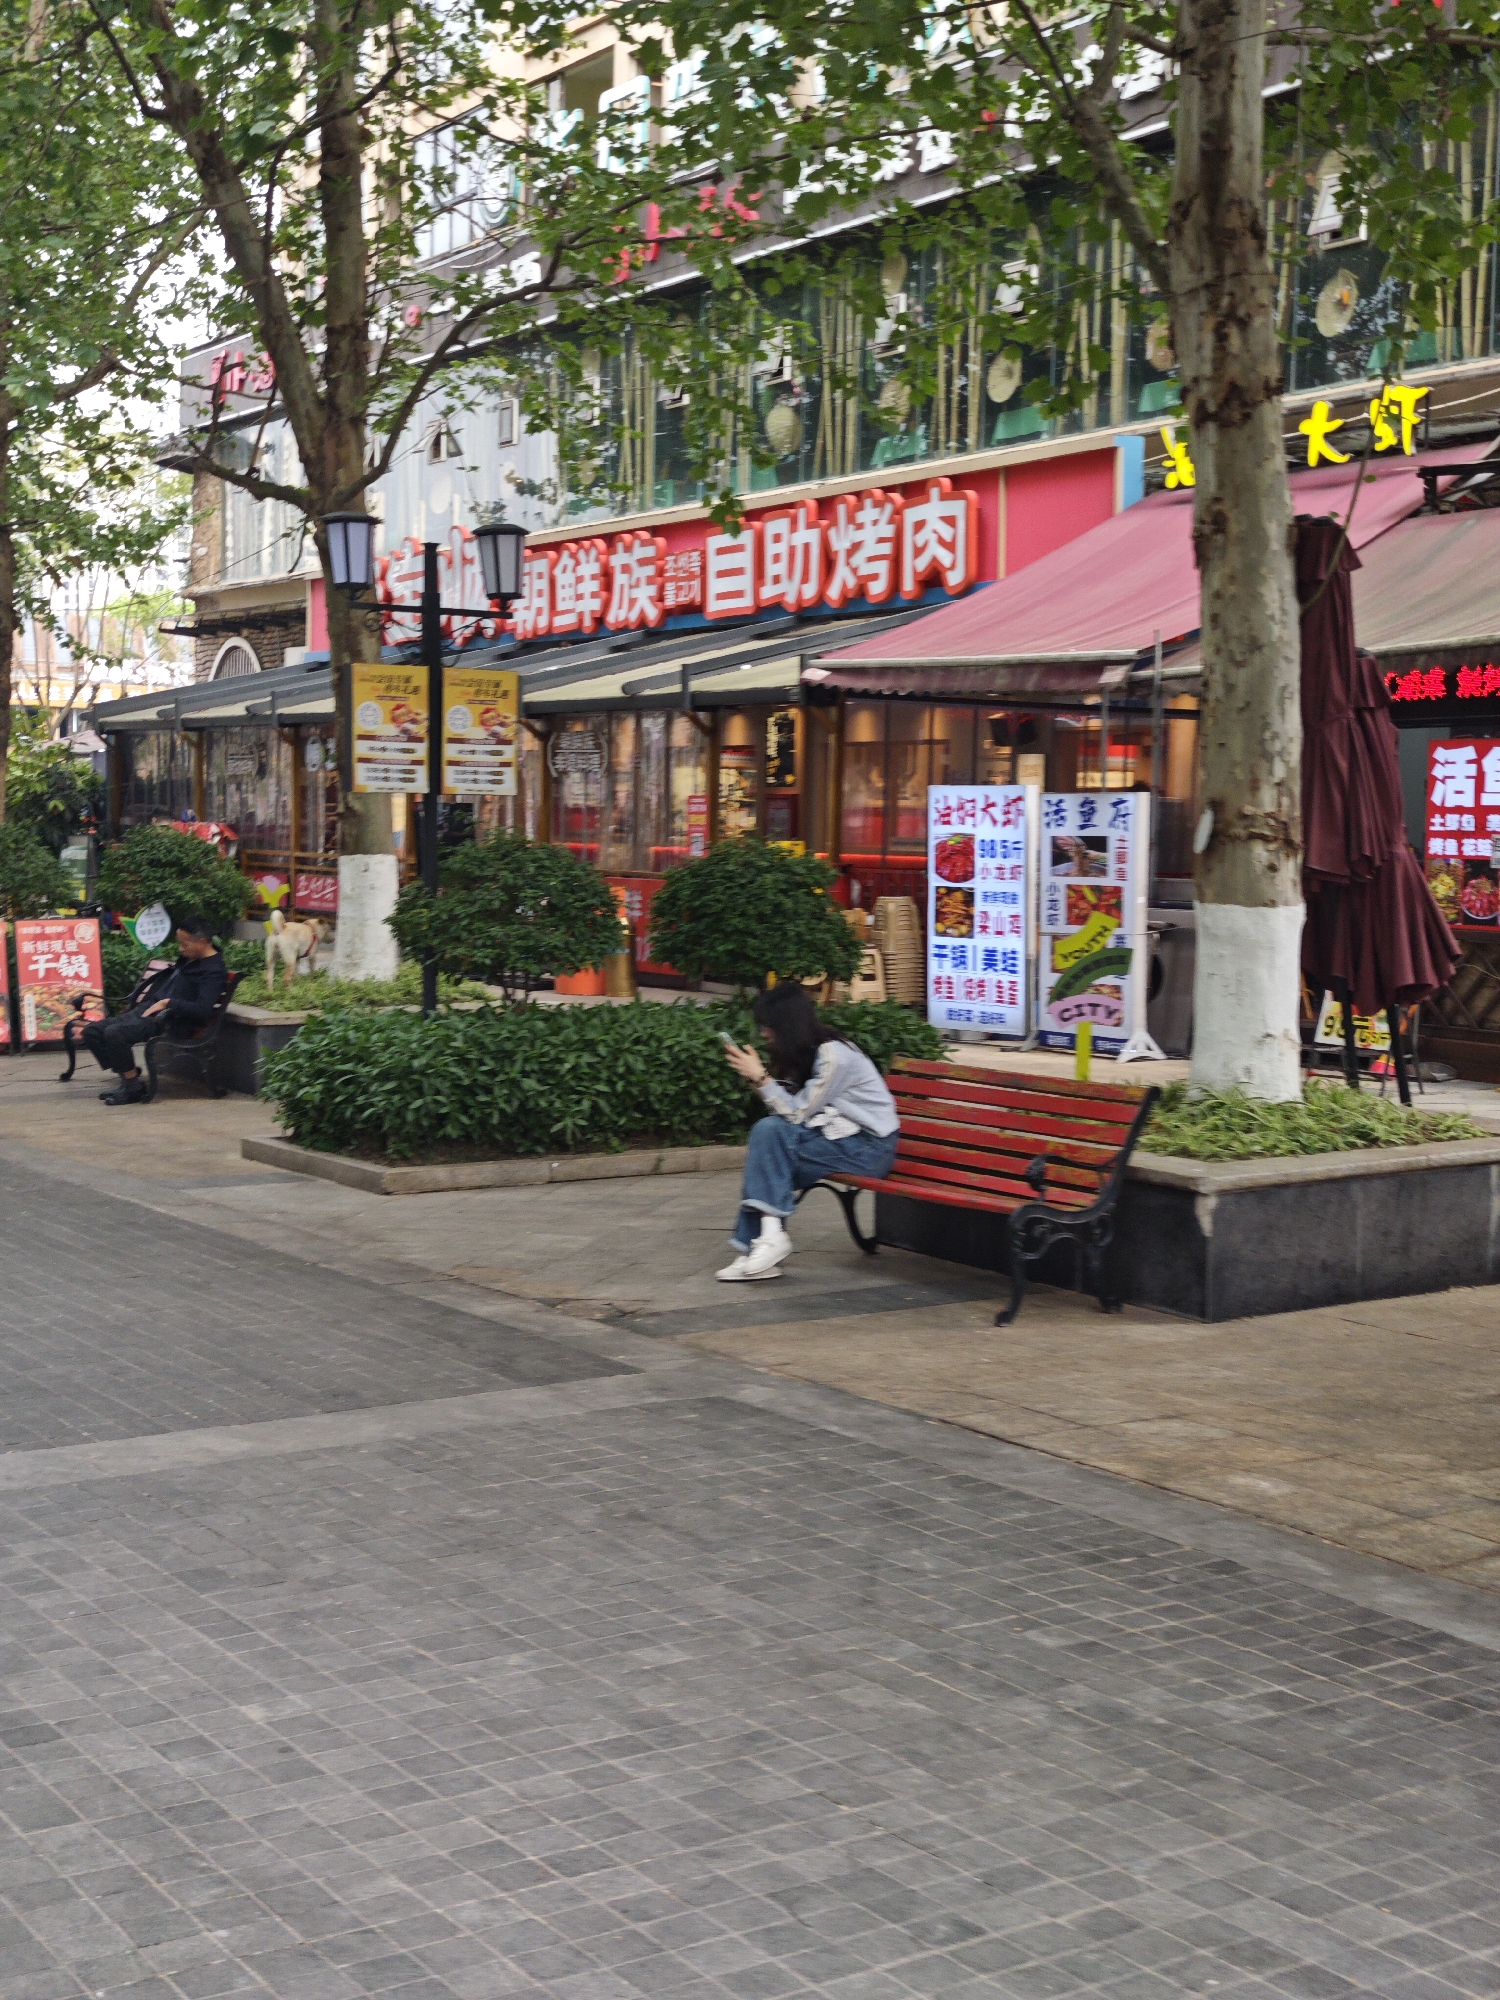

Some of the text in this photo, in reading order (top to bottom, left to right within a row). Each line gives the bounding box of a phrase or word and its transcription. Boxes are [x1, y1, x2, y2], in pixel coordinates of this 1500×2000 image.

[705, 486, 968, 613] 自助烤肉
[934, 794, 1025, 829] 油焖大虾
[1044, 797, 1133, 832] 活鱼府
[979, 863, 1024, 881] 小龙虾
[1045, 882, 1062, 926] 小龙虾
[931, 944, 1020, 975] 干锅 美蛙
[1059, 924, 1111, 962] YOUTH
[28, 954, 91, 979] 干锅
[1059, 1002, 1121, 1023] CITY
